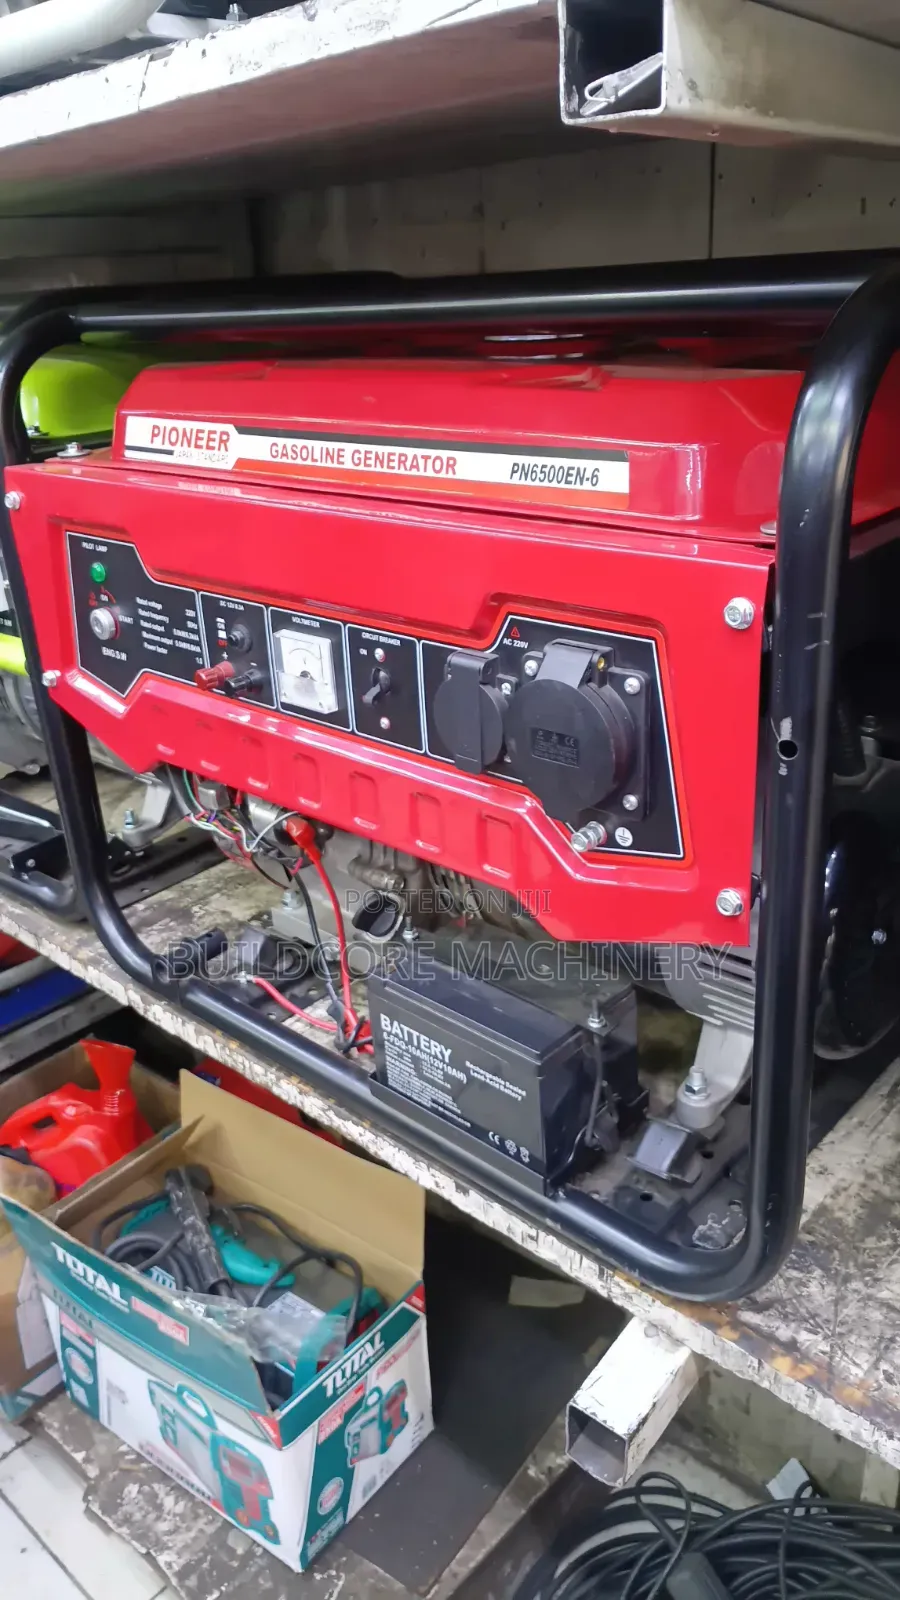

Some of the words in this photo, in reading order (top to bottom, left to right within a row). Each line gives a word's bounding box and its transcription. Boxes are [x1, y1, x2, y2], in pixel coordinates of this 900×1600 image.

[150, 424, 230, 452] PIONEER
[270, 442, 345, 466] GASOLINE
[351, 449, 457, 475] GENERATOR
[510, 462, 600, 487] PN6500EN-6
[82, 541, 95, 550] PILOT
[95, 544, 108, 553] LAMP
[118, 614, 134, 624] START
[291, 616, 321, 628] VOLTMETER
[361, 631, 379, 642] CIRCUIT
[379, 635, 401, 646] BREAKER
[502, 638, 513, 647] AC
[513, 640, 529, 650] 220V
[359, 647, 368, 656] ON
[380, 1013, 452, 1064] BATTERY
[50, 1241, 129, 1306] TOTAL
[322, 1331, 385, 1398] TOTAL
